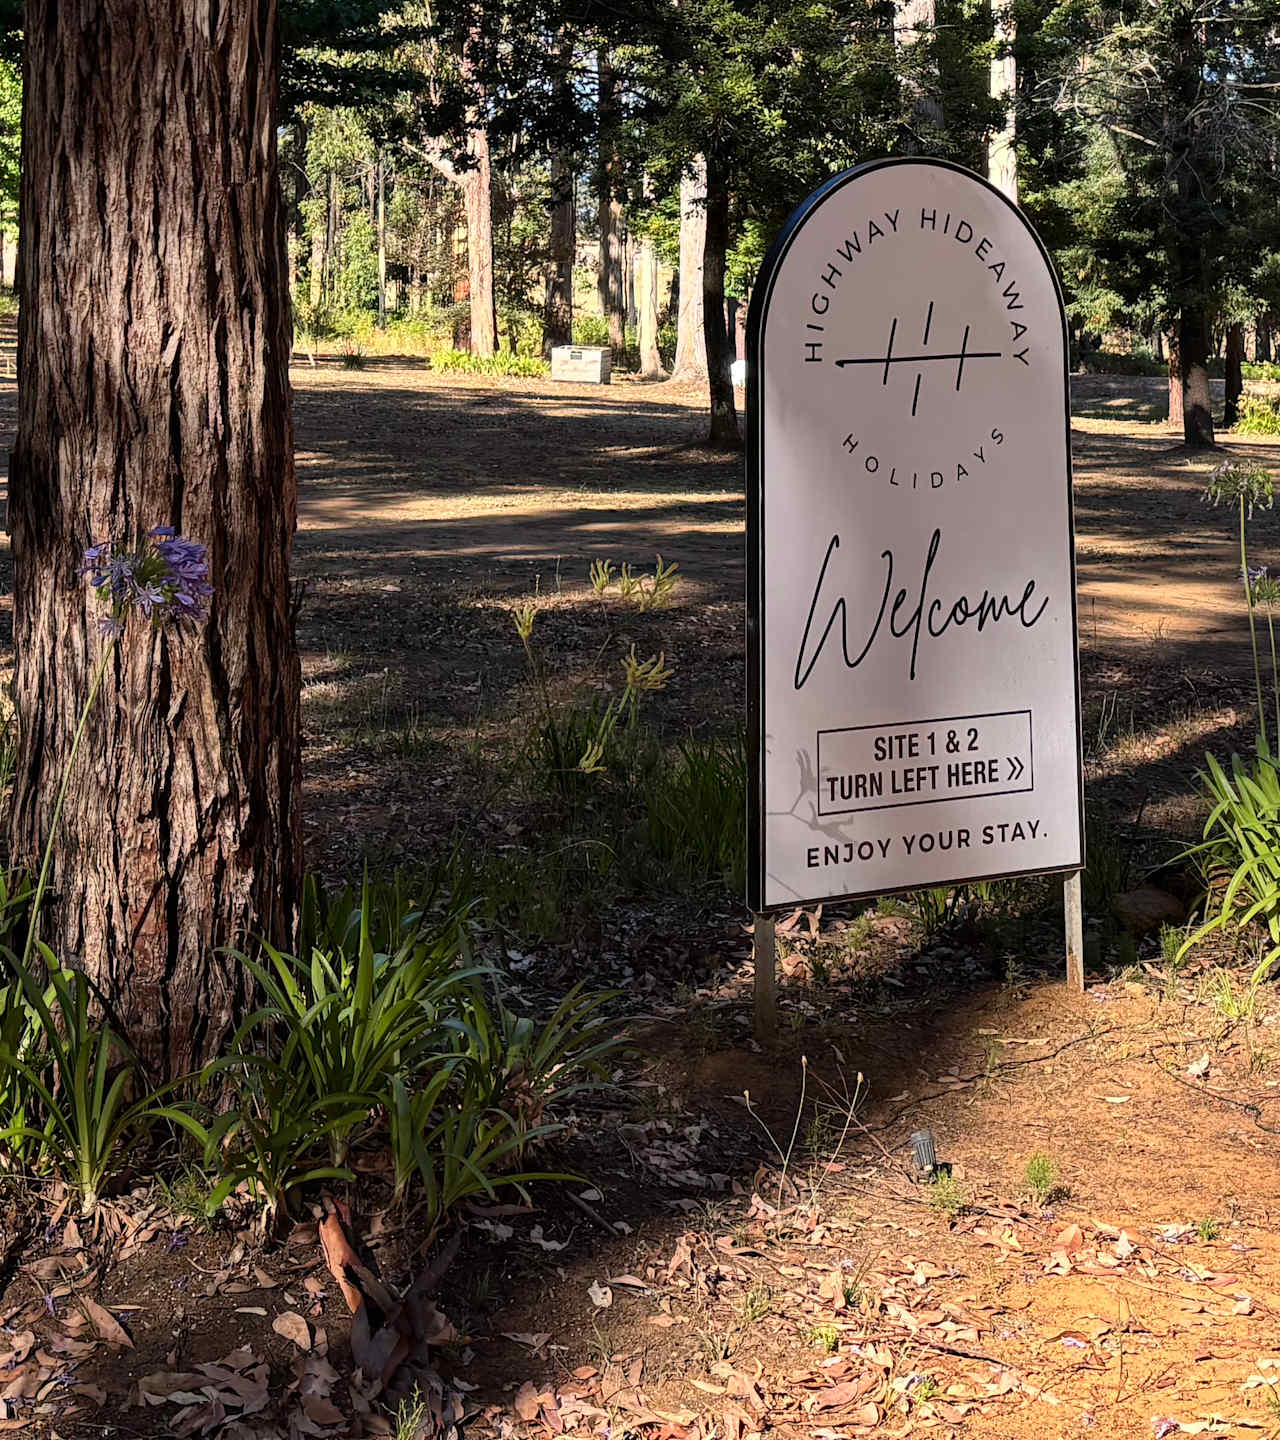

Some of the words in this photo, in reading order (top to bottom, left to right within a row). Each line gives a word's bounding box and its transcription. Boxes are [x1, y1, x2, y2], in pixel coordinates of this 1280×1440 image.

[804, 208, 901, 363] HIGHWAY
[920, 207, 1030, 367] HIDEAWAY
[842, 427, 1004, 489] HOLIDAYS
[794, 528, 1049, 690] Welcome
[873, 733, 920, 761] SITE
[926, 731, 937, 756] 1
[945, 730, 961, 754] &
[967, 728, 980, 752] 2
[826, 772, 883, 801] TURN
[891, 766, 940, 794] LEFT
[947, 758, 1000, 788] HERE
[806, 839, 892, 868] ENJOY
[902, 829, 971, 854] YOUR
[982, 819, 1049, 844] STAY.
